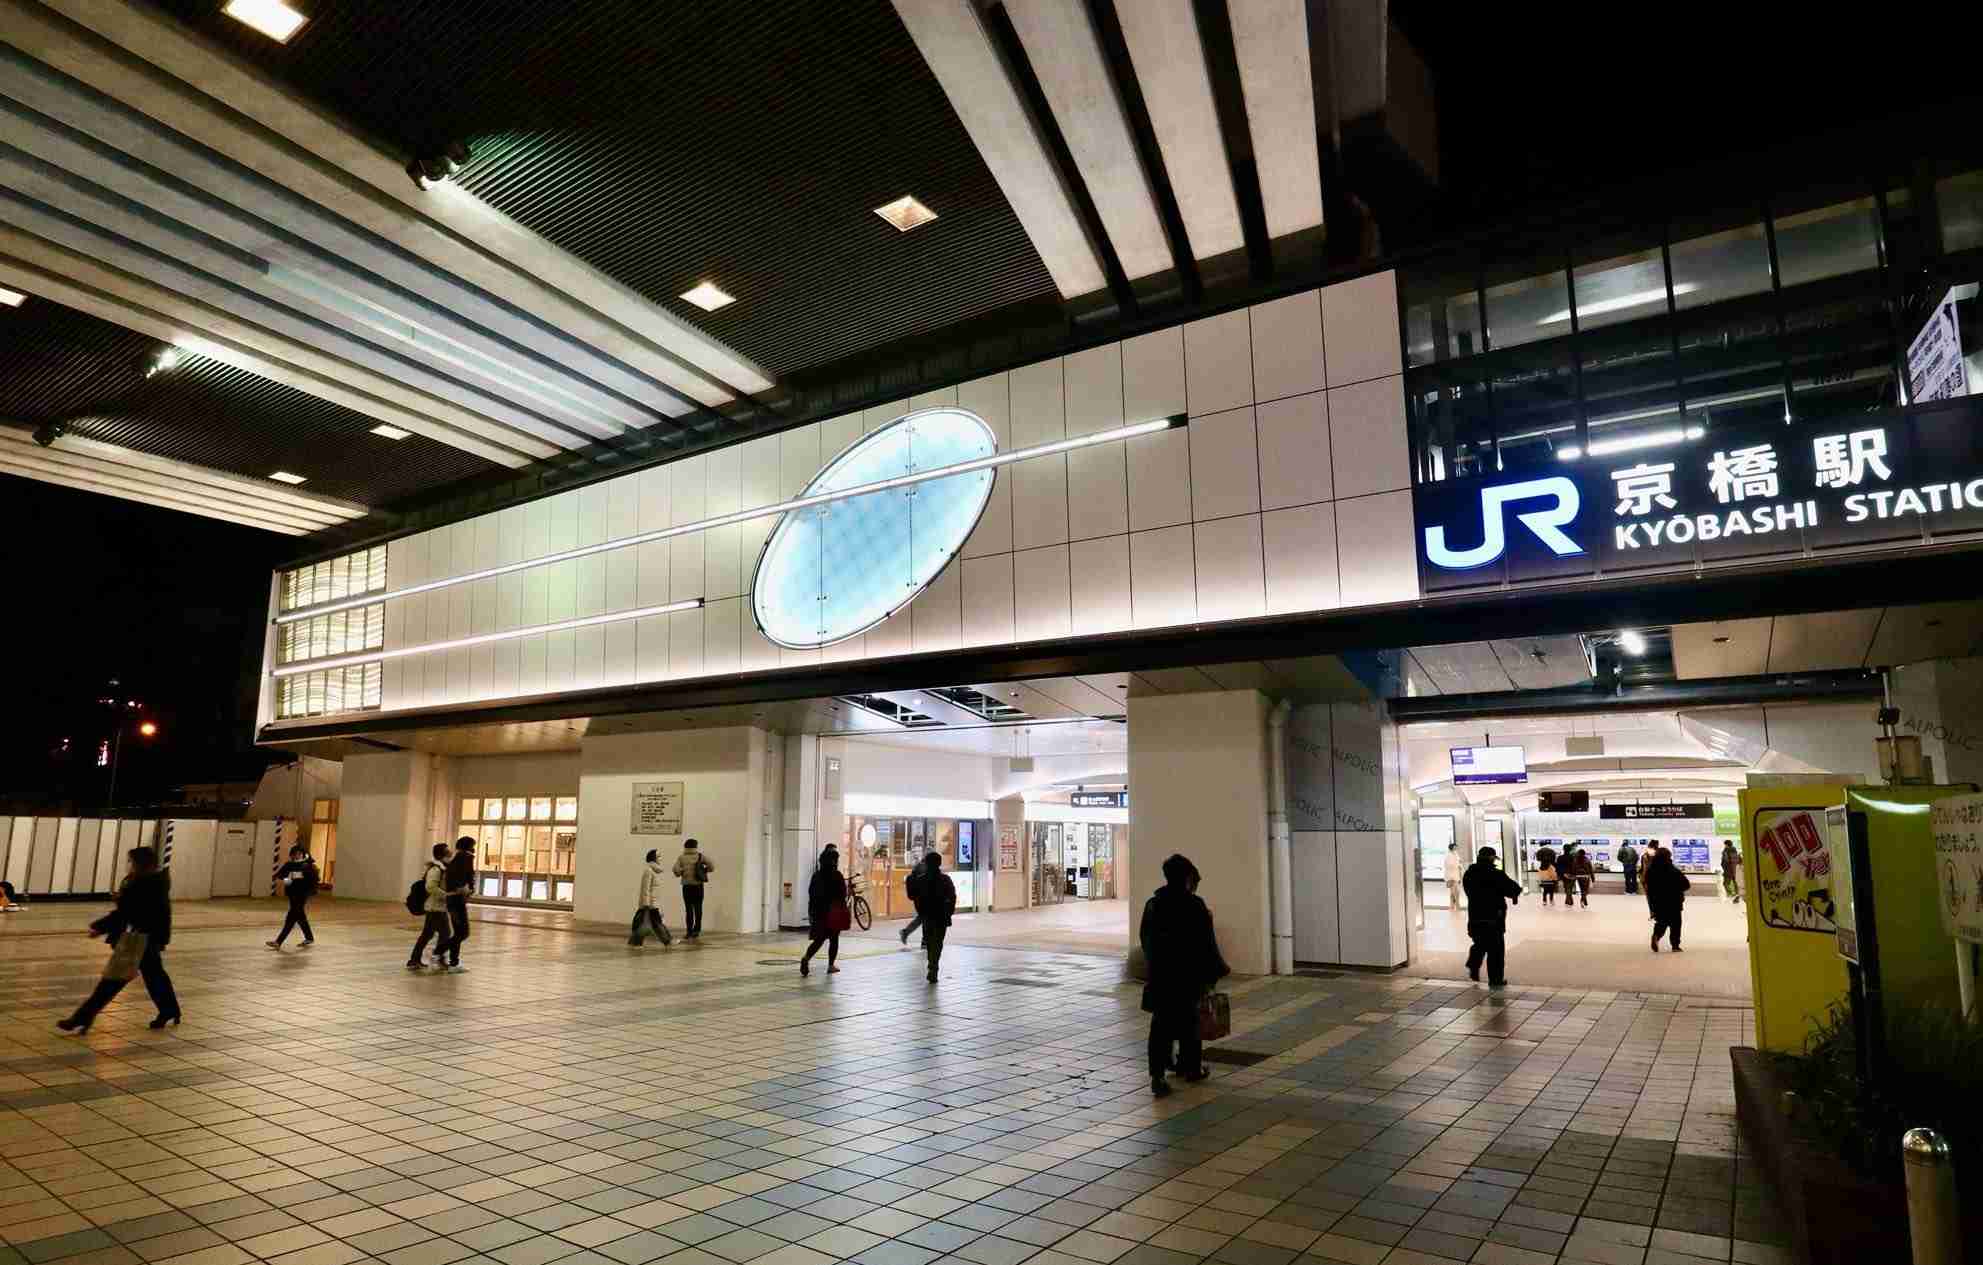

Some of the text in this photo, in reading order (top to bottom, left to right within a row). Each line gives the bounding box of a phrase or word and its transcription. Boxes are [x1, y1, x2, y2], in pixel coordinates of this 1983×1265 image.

[1611, 428, 1892, 516] 京橋駅
[1425, 477, 1584, 568] JR
[1760, 811, 1822, 873] 100
